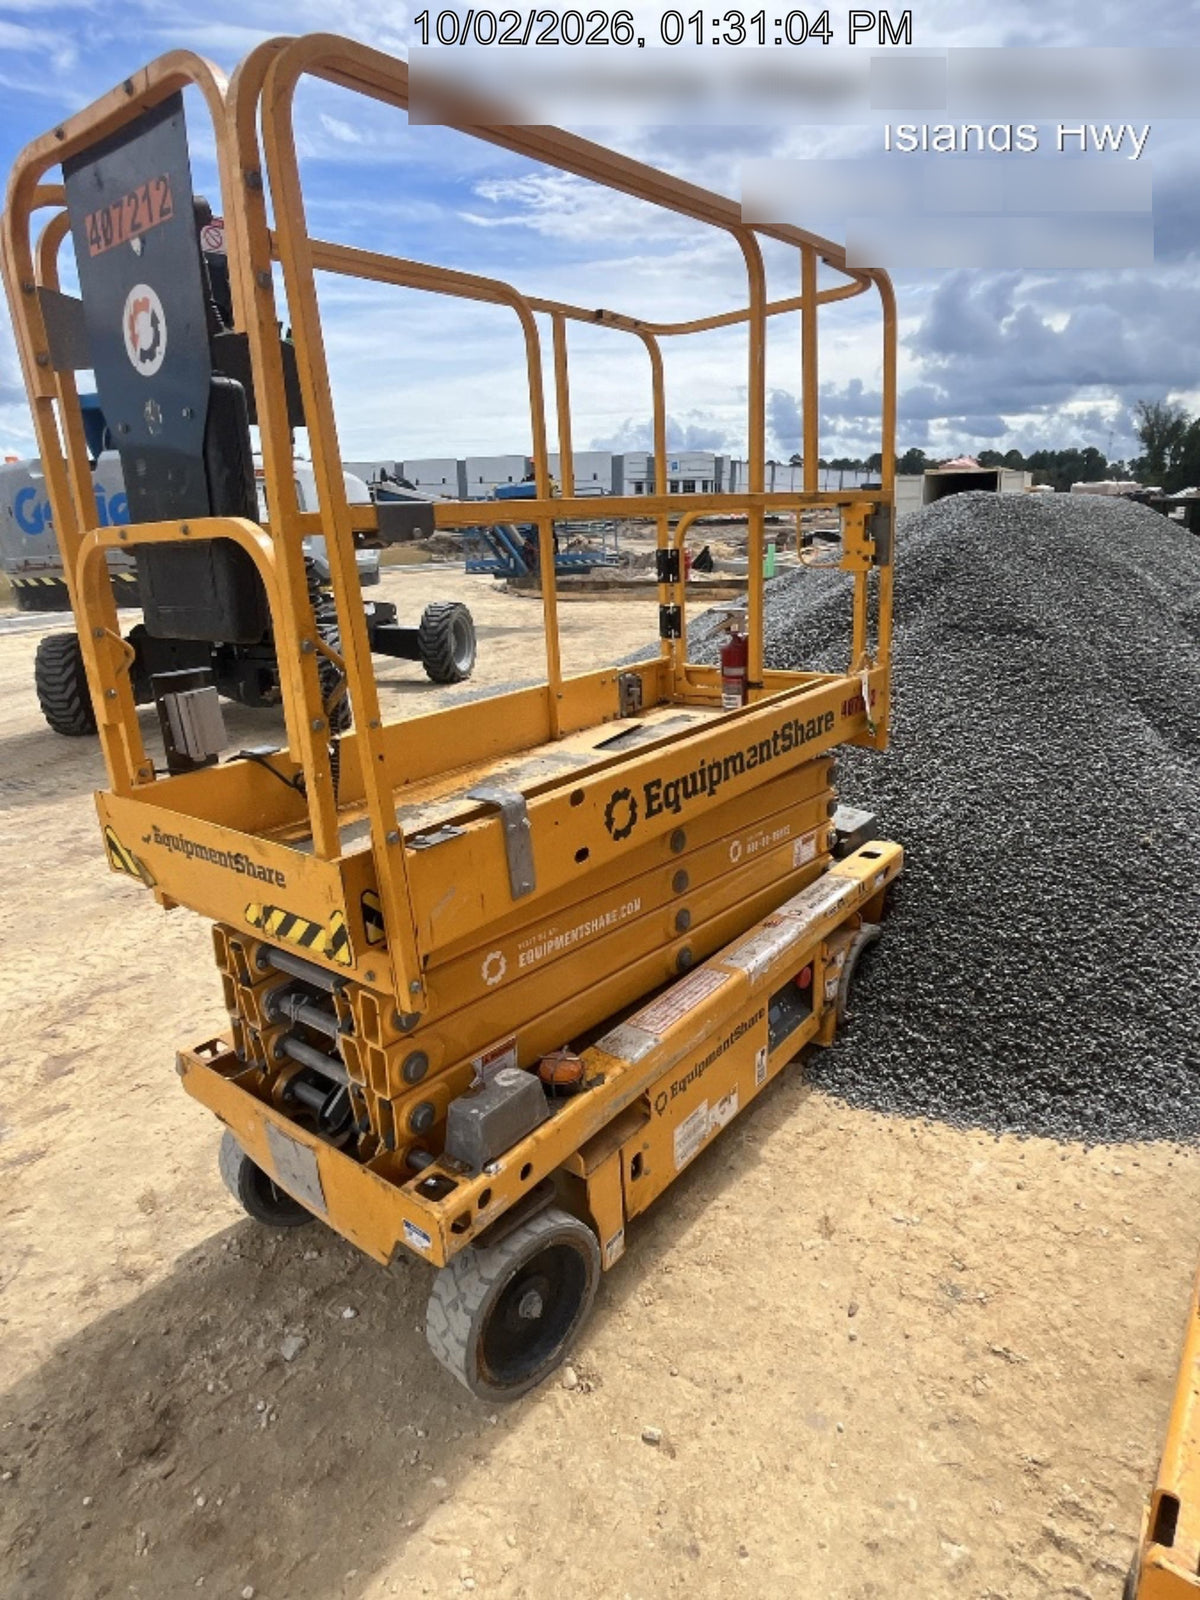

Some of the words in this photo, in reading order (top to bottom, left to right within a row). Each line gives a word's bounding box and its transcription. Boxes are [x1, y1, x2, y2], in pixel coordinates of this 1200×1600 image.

[89, 175, 171, 250] 407212
[14, 484, 131, 535] Gie
[643, 710, 835, 820] EquipmentShare
[518, 897, 642, 969] EQUIPMENTSHARE.COM
[669, 1007, 766, 1101] EquipmentShare
